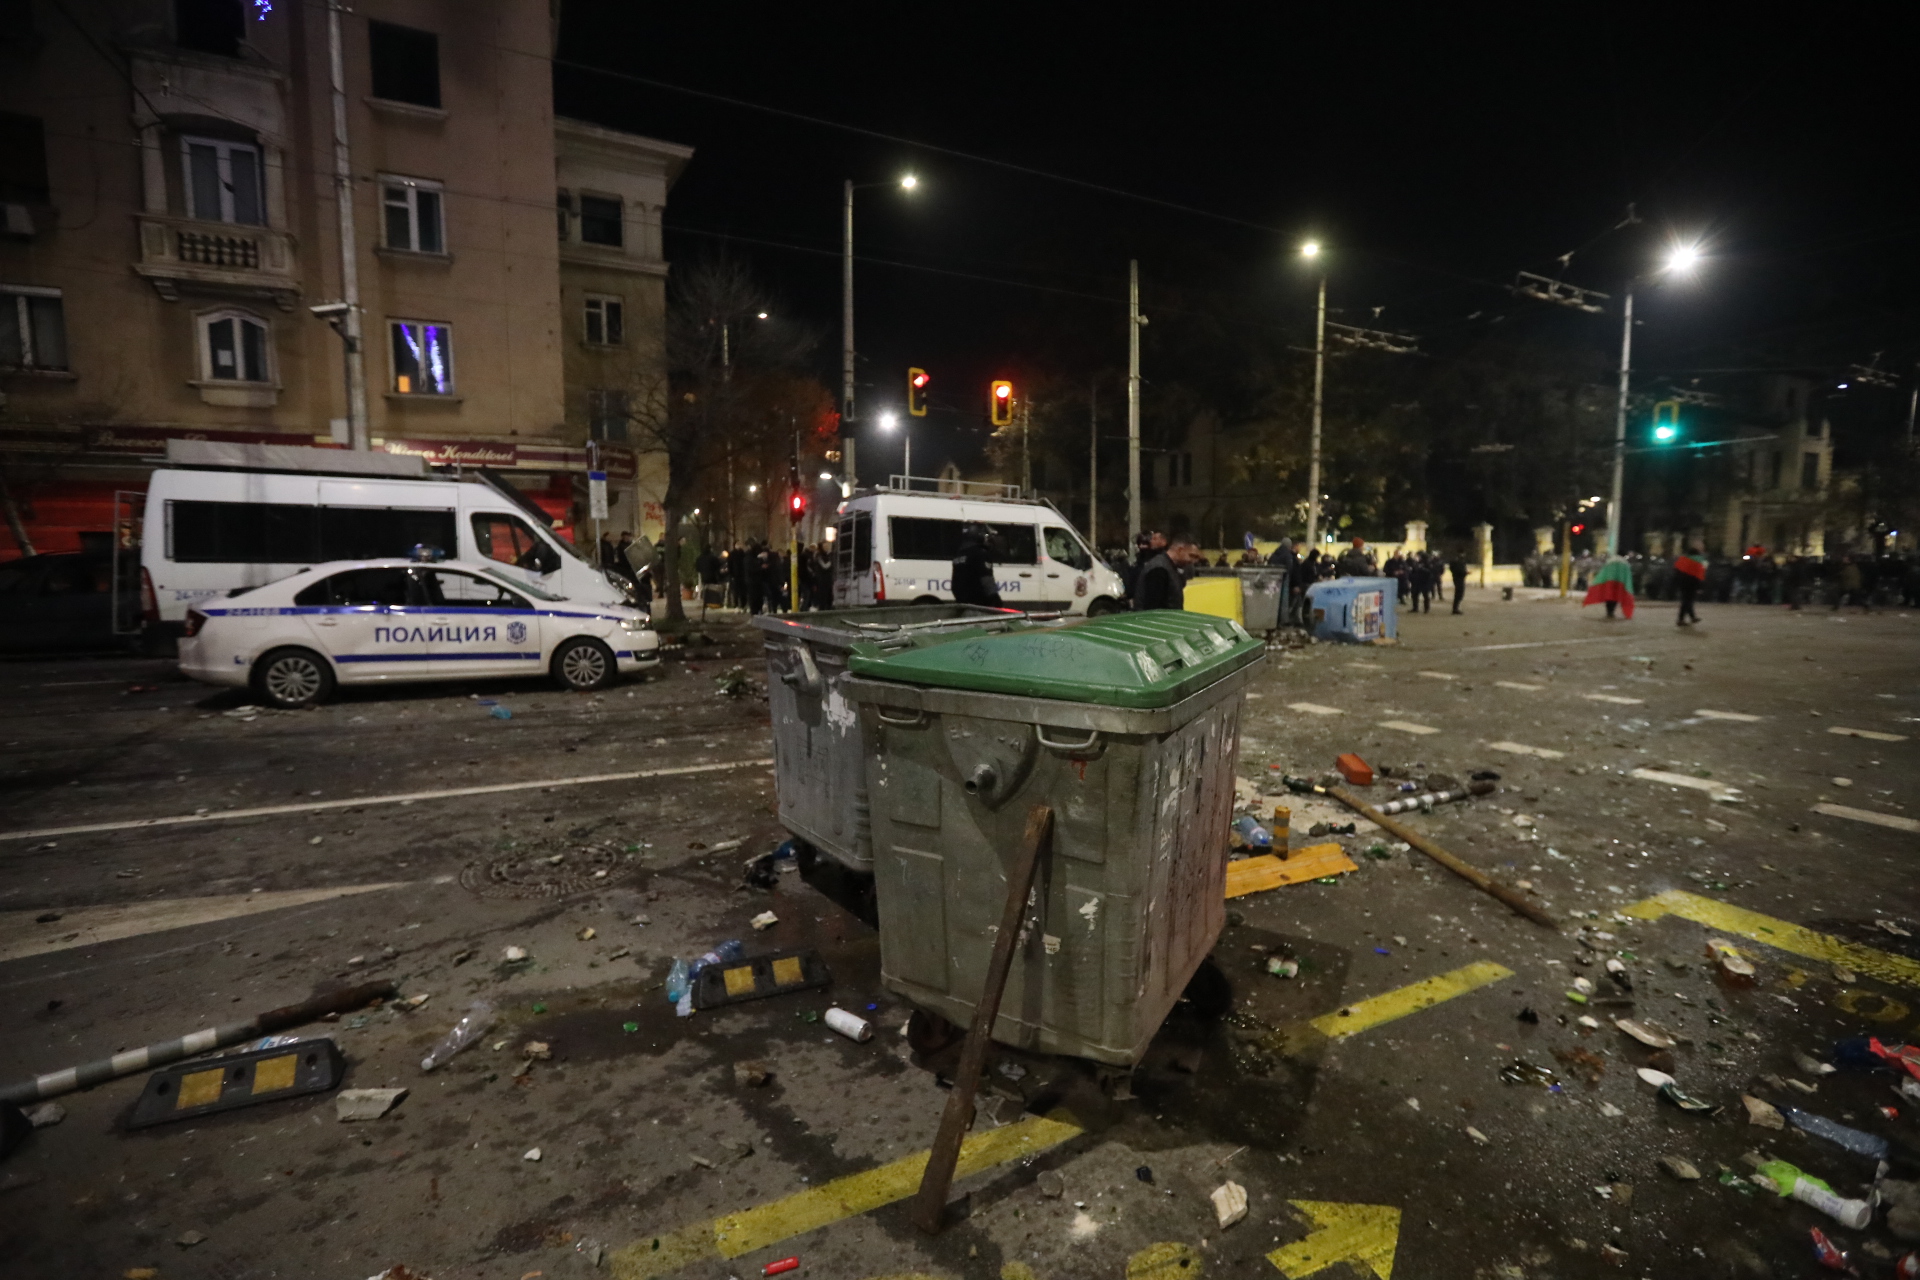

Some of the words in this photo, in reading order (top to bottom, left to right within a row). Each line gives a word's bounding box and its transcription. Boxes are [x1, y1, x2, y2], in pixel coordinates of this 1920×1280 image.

[438, 444, 514, 461] Konditorei
[927, 578, 1021, 593] ПОИЯ
[375, 626, 496, 644] ПОЛИЦИЯ
